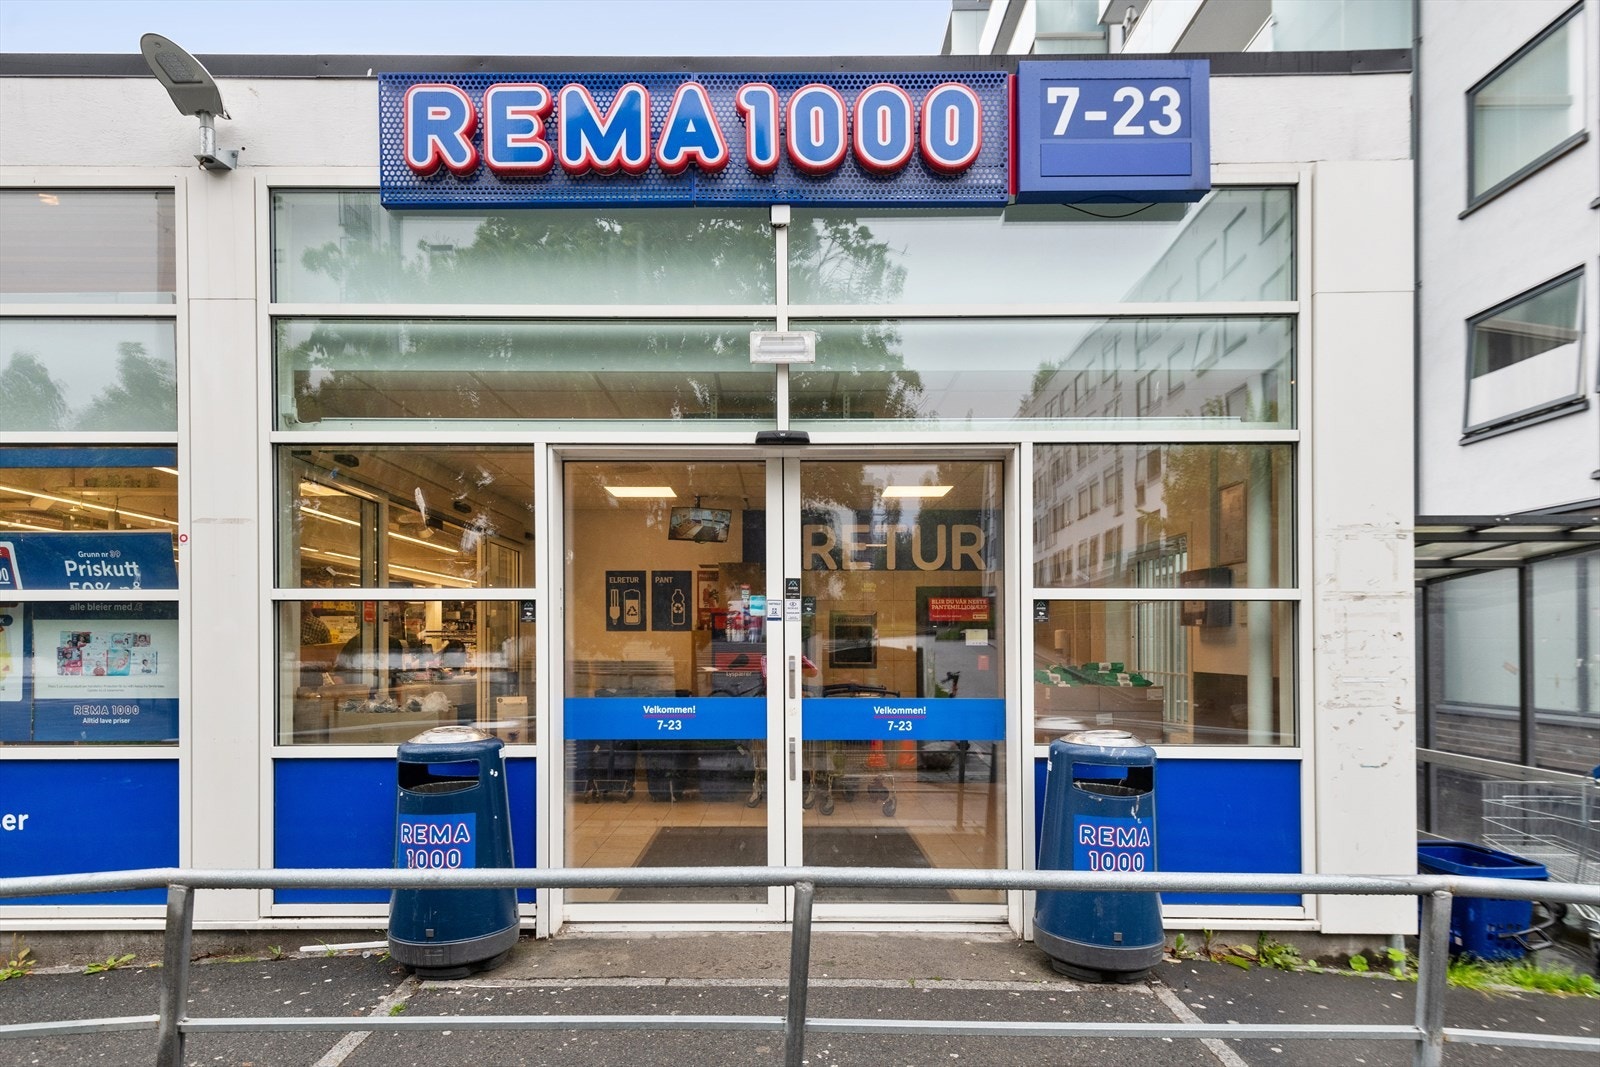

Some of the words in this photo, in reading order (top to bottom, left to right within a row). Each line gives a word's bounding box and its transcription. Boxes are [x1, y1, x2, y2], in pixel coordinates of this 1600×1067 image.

[1047, 86, 1182, 136] 7-23
[404, 82, 729, 177] REMA
[736, 82, 982, 176] 1000
[802, 524, 986, 571] RETUR
[78, 550, 100, 558] Grunn
[64, 560, 141, 577] Priskutt
[609, 576, 639, 584] ELRETUR
[655, 576, 673, 584] PANT
[69, 602, 84, 611] alle
[87, 602, 112, 611] bleier
[113, 602, 132, 611] med
[73, 704, 109, 716] REMA
[111, 704, 140, 716] 1000
[643, 705, 696, 714] Velkommen!
[873, 706, 926, 715] Velkommen!
[113, 717, 131, 725] priser
[656, 719, 682, 730] 7-23
[887, 720, 913, 731] 7-23
[0, 813, 29, 831] er
[400, 823, 471, 844] REMA
[1079, 824, 1151, 848] REMA
[406, 849, 462, 869] 1000
[1088, 850, 1145, 872] 1000
